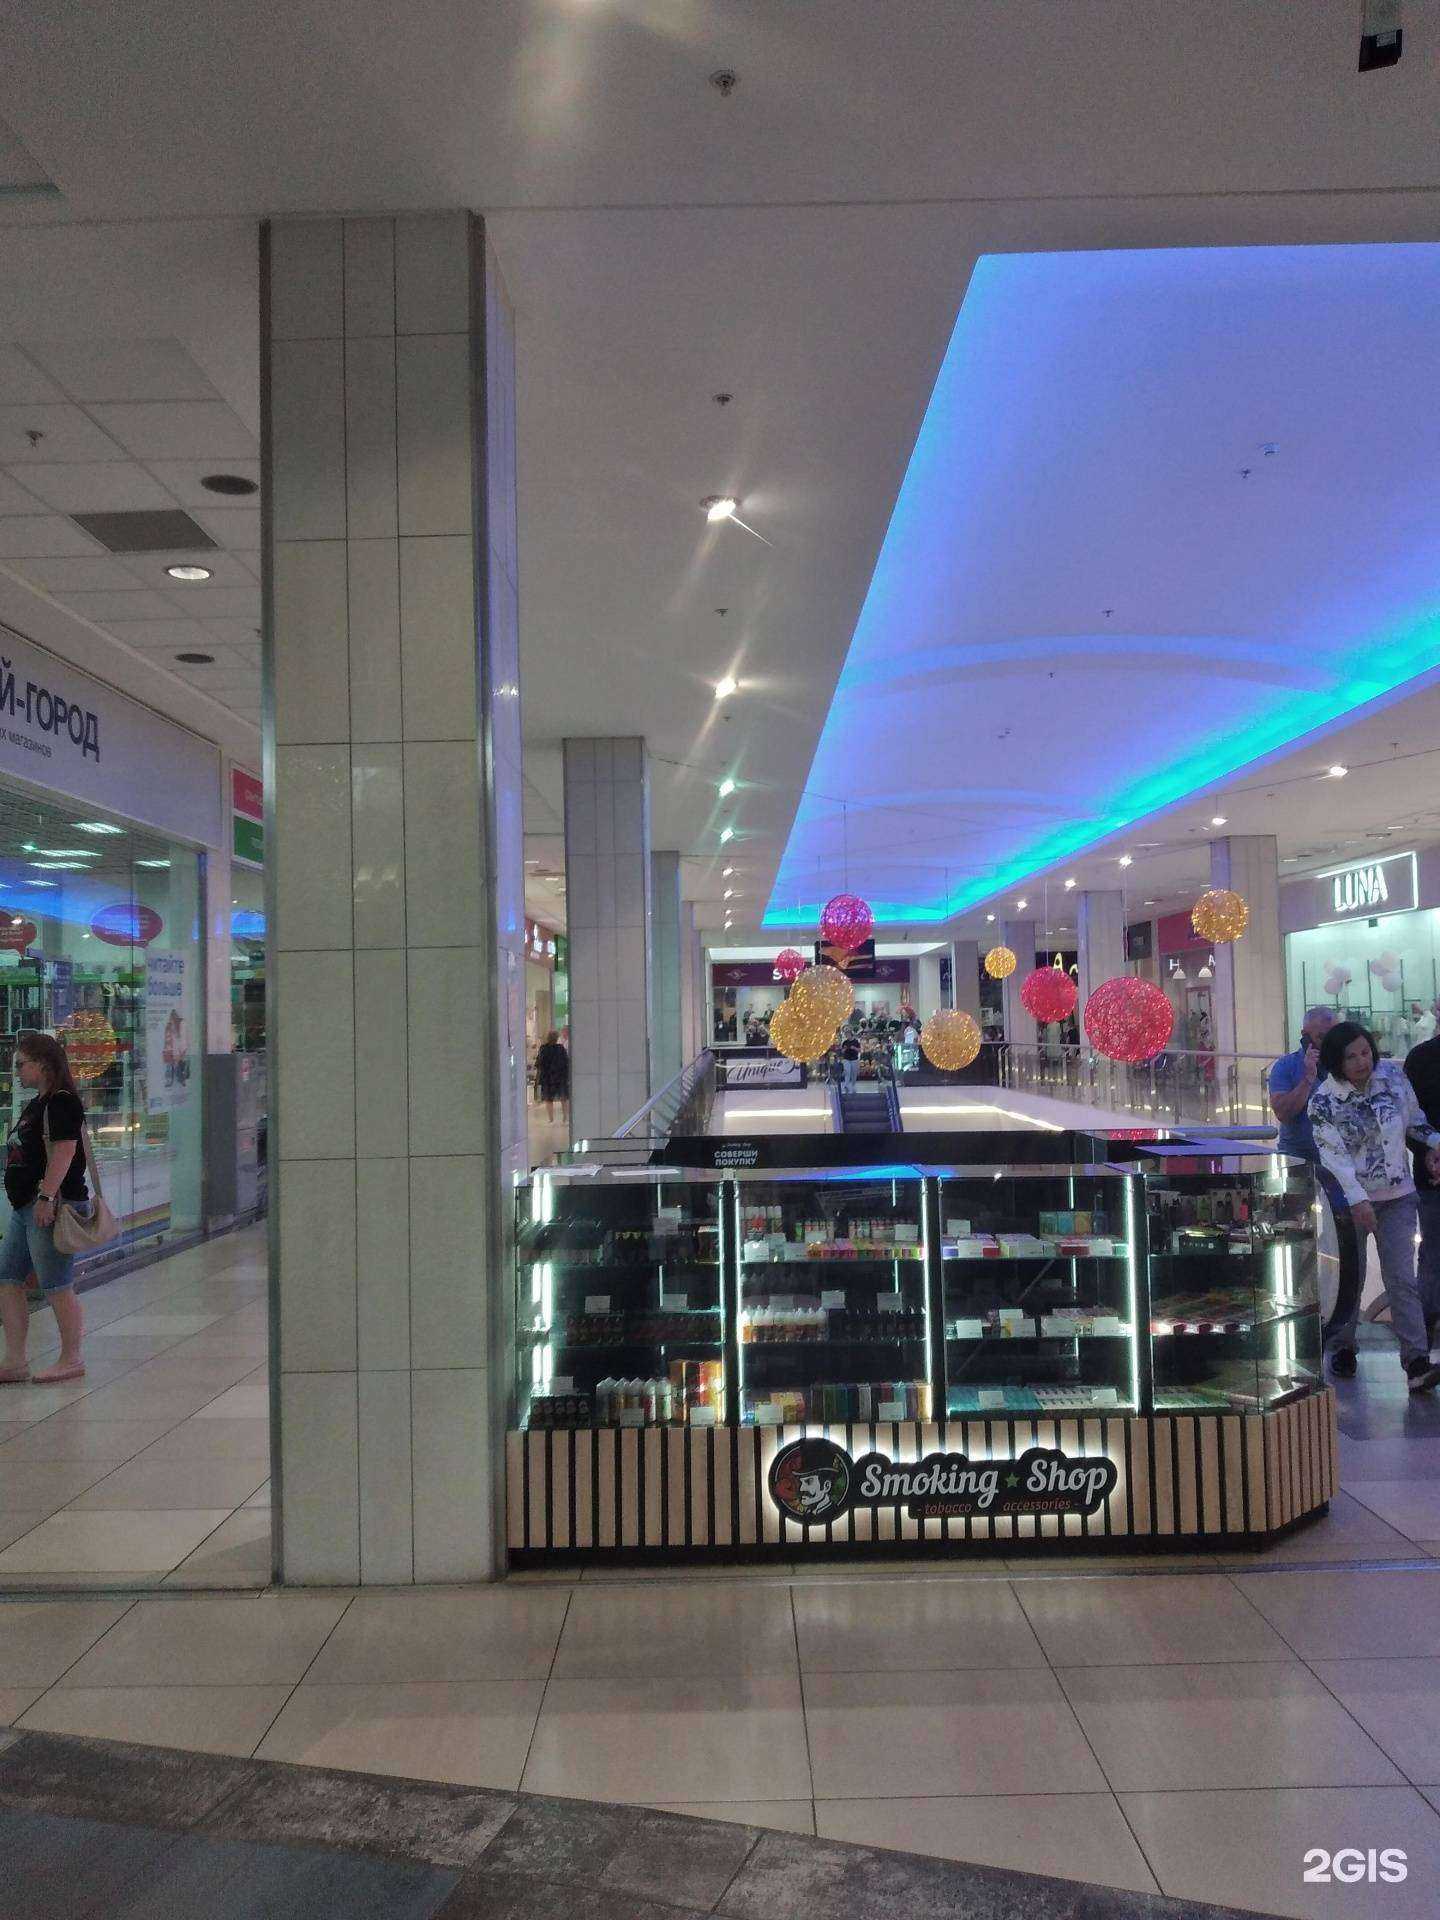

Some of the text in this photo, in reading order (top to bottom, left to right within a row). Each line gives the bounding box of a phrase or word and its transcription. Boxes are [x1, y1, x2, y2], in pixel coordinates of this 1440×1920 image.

[1333, 864, 1388, 912] LUNA
[713, 1150, 758, 1159] СОВЕРШИ
[715, 1157, 756, 1166] ПОКУПКУ
[860, 1459, 1108, 1509] Smoking Shop
[1002, 1498, 1071, 1512] accessories
